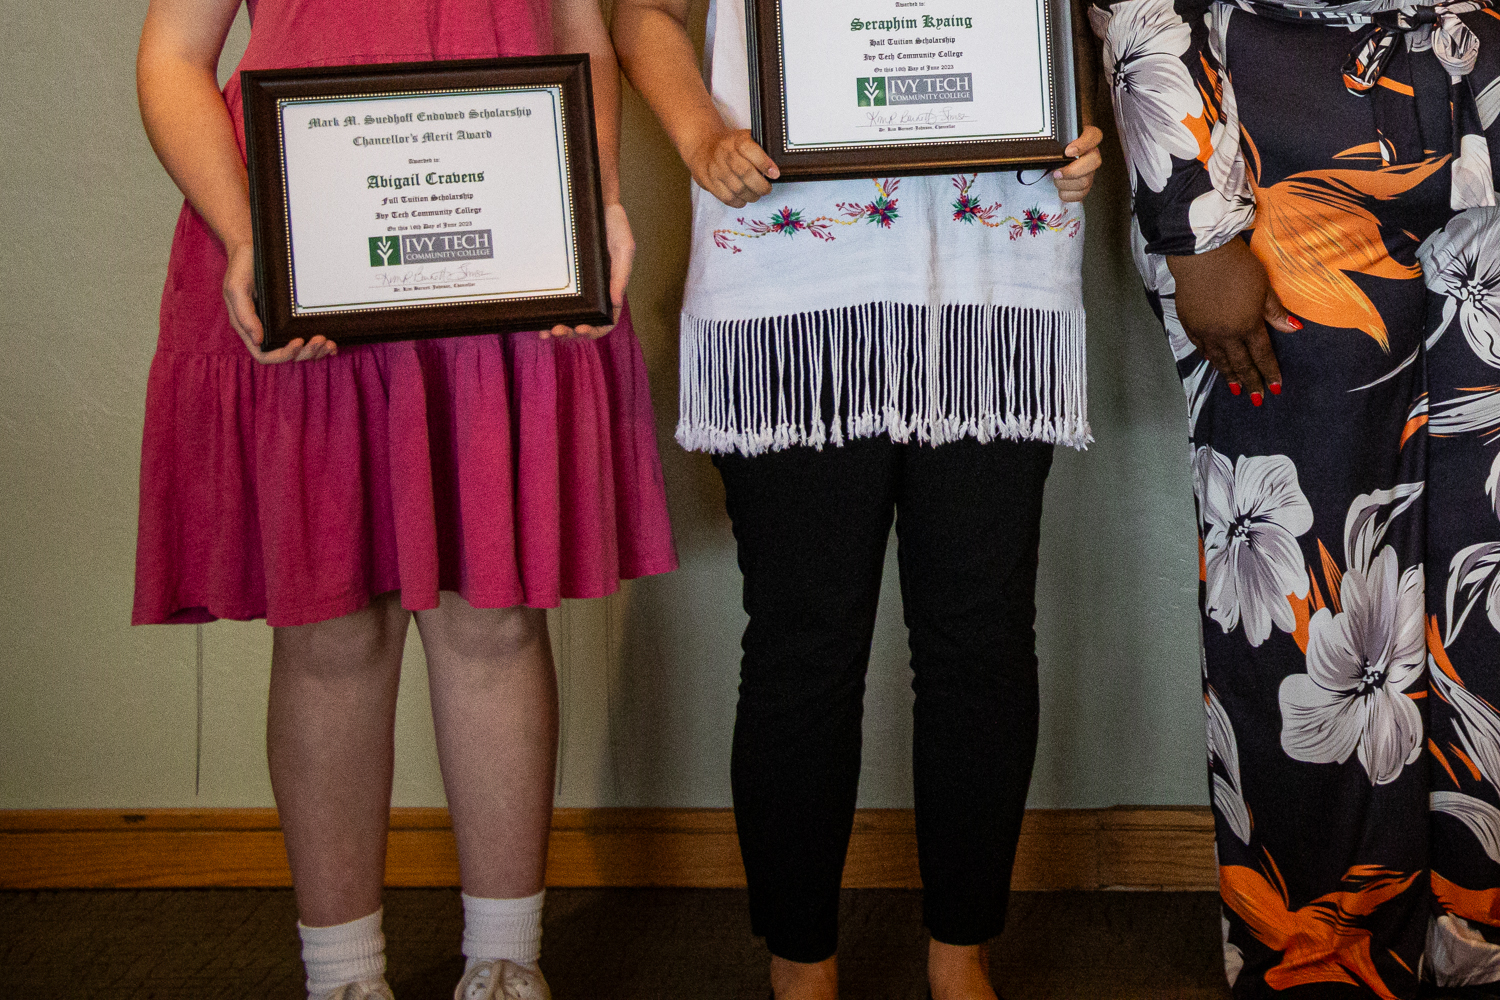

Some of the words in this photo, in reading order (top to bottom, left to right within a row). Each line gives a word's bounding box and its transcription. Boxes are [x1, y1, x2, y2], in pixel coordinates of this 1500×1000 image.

[850, 16, 917, 31] Seraphim
[921, 14, 972, 30] Kyaing
[869, 39, 885, 47] Half
[915, 36, 955, 44] Scholarship
[863, 53, 876, 61] Ivy
[937, 50, 963, 58] College
[890, 79, 921, 93] IVY
[923, 77, 969, 92] TECH
[891, 93, 938, 101] COMMUNITY
[939, 91, 970, 99] COLLEGE
[307, 117, 339, 129] Mark
[343, 115, 360, 127] M.
[364, 112, 413, 125] Suedhoff
[416, 110, 465, 122] Endowed
[468, 107, 531, 119] Scholarship
[421, 132, 453, 143] Merit
[456, 129, 492, 140] Award
[366, 173, 420, 190] Abigail
[425, 171, 484, 185] Cravens
[381, 197, 398, 206] Full
[430, 192, 473, 201] Scholarship
[375, 212, 389, 220] Ivy
[411, 209, 452, 217] Community
[405, 236, 438, 252] IVY
[440, 233, 488, 249] TECH
[406, 250, 458, 260] COMMUNITY
[459, 248, 490, 256] COLLEGE
